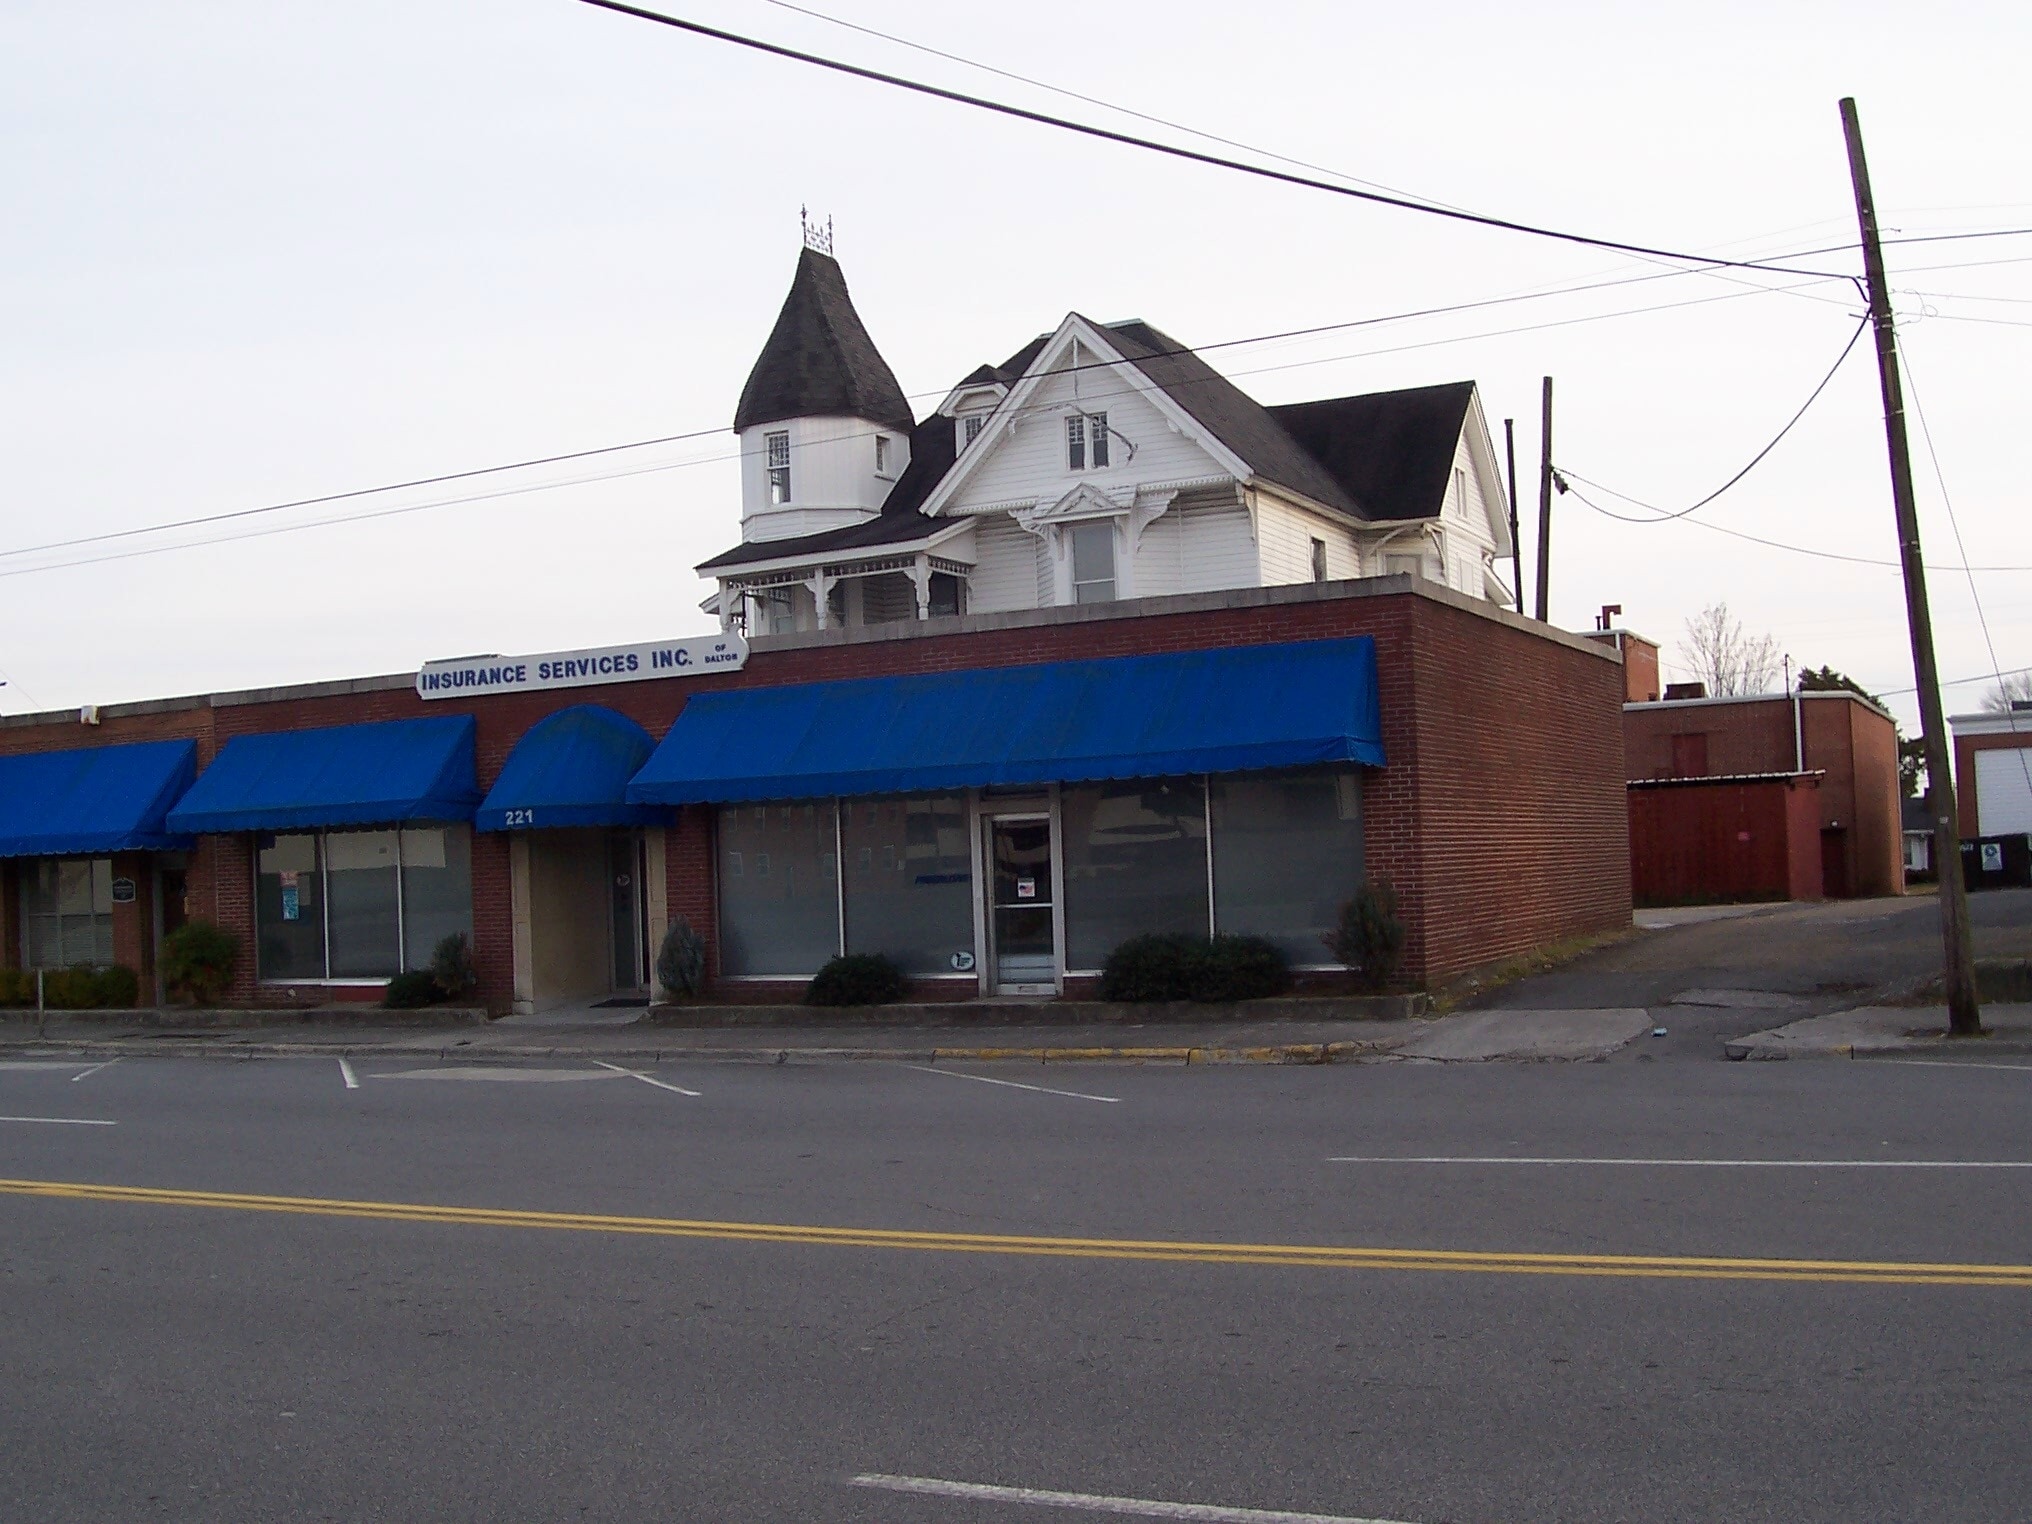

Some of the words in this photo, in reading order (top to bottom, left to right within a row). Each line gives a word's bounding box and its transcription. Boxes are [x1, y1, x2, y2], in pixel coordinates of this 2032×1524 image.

[714, 644, 727, 653] OF
[422, 665, 526, 690] INSURANCE
[538, 653, 639, 679] SERVICES
[651, 648, 694, 669] INC.
[504, 808, 534, 826] 221
